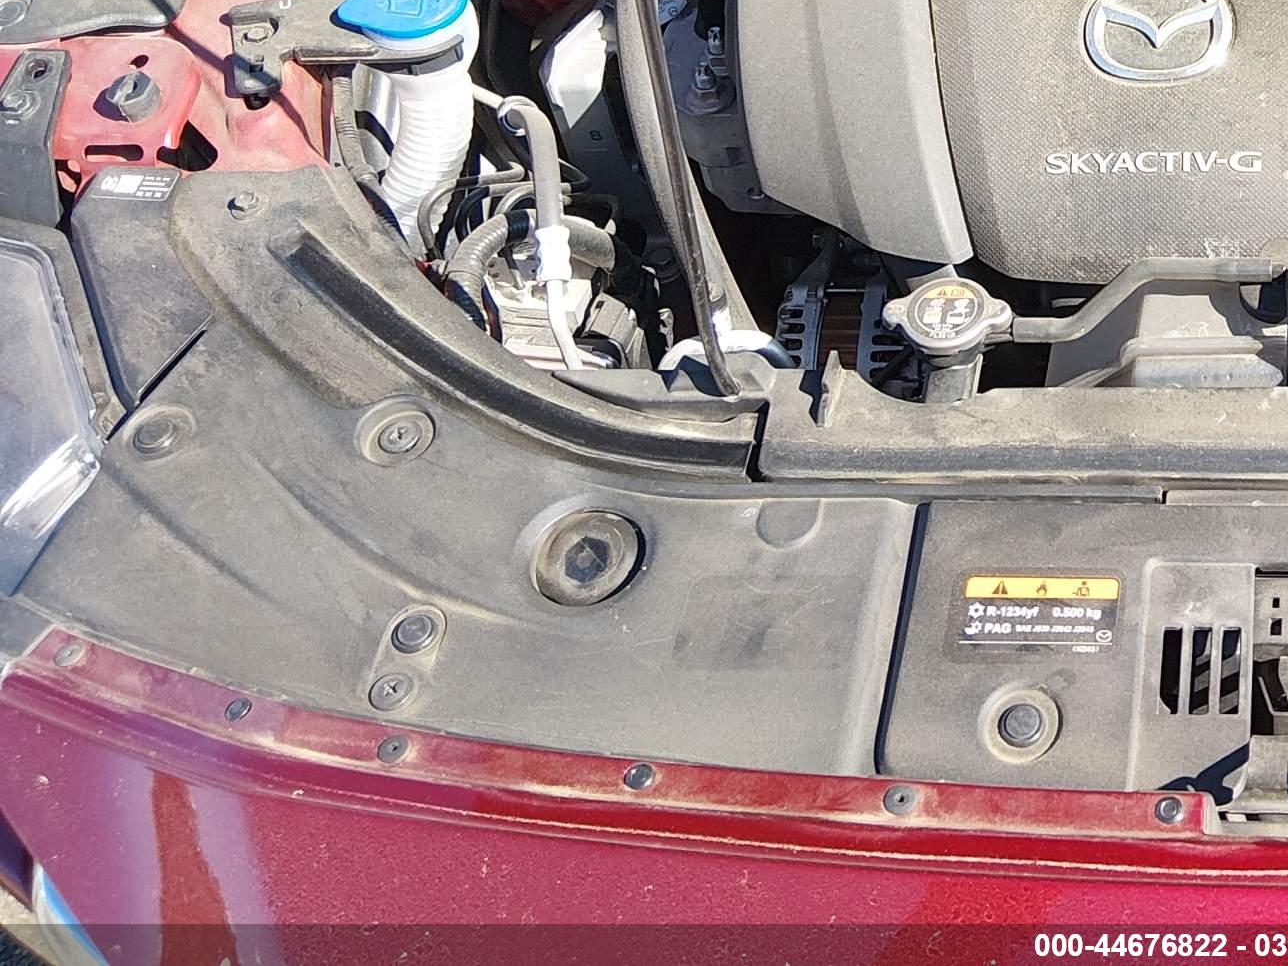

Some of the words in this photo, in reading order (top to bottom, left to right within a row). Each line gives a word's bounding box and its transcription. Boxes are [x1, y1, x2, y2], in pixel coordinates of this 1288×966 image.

[1045, 150, 1263, 174] SKYACTIV-G
[986, 606, 1039, 619] R-1234yf
[1086, 608, 1102, 621] kg
[984, 623, 1011, 634] PAG
